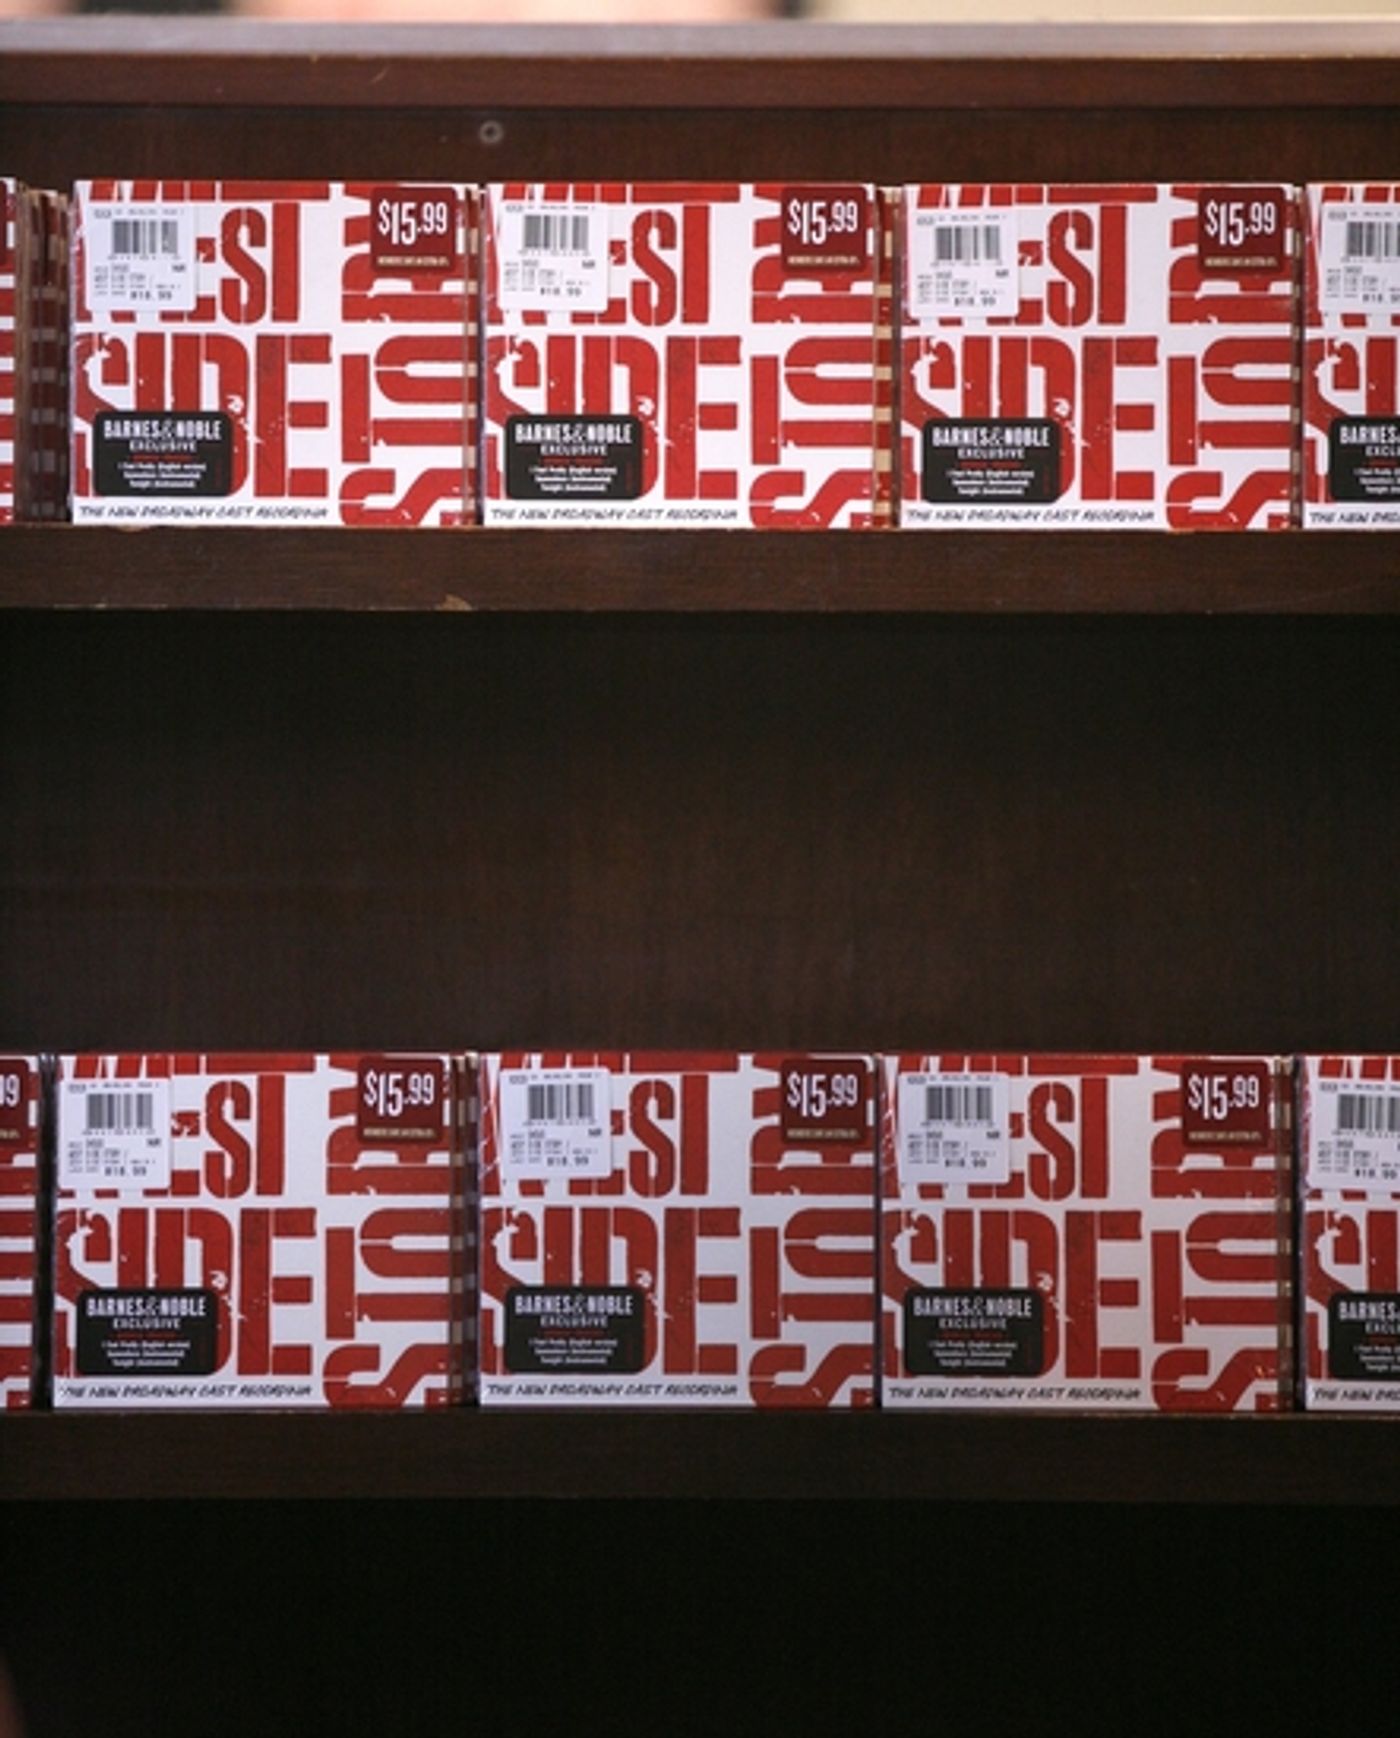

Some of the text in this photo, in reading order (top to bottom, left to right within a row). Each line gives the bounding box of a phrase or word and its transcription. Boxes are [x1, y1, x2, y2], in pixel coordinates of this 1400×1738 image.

[378, 198, 449, 246] $15.99
[788, 197, 859, 245] $15.99
[1206, 199, 1277, 247] $15.99
[75, 181, 329, 324] EST
[486, 184, 740, 326] EST
[902, 185, 1158, 327] EST
[1339, 425, 1400, 445] BARNES
[129, 440, 197, 453] EXCLUSIVE
[540, 444, 608, 457] EXCLUSIVE
[957, 447, 1025, 460] EXCLUSIVE
[80, 505, 104, 518] THE
[107, 505, 137, 518] NEW
[491, 508, 515, 521] THE
[518, 508, 548, 521] NEW
[907, 509, 931, 522] THE
[934, 509, 965, 522] NEW
[365, 1069, 436, 1117] $15.99
[788, 1070, 859, 1118] $15.99
[1189, 1072, 1260, 1120] $15.99
[58, 1054, 315, 1198] EST
[482, 1054, 738, 1198] EST
[883, 1056, 1138, 1201] EST
[1338, 1301, 1400, 1321] BARNES
[113, 1318, 181, 1331] EXCLUSIVE
[540, 1316, 608, 1329] EXCLUSIVE
[939, 1318, 1007, 1331] EXCLUSIVE
[60, 1384, 84, 1398] THE
[88, 1384, 119, 1398] NEW
[487, 1383, 514, 1396] THE
[515, 1383, 547, 1396] NEW
[888, 1386, 914, 1399] THE
[917, 1386, 947, 1399] NEW
